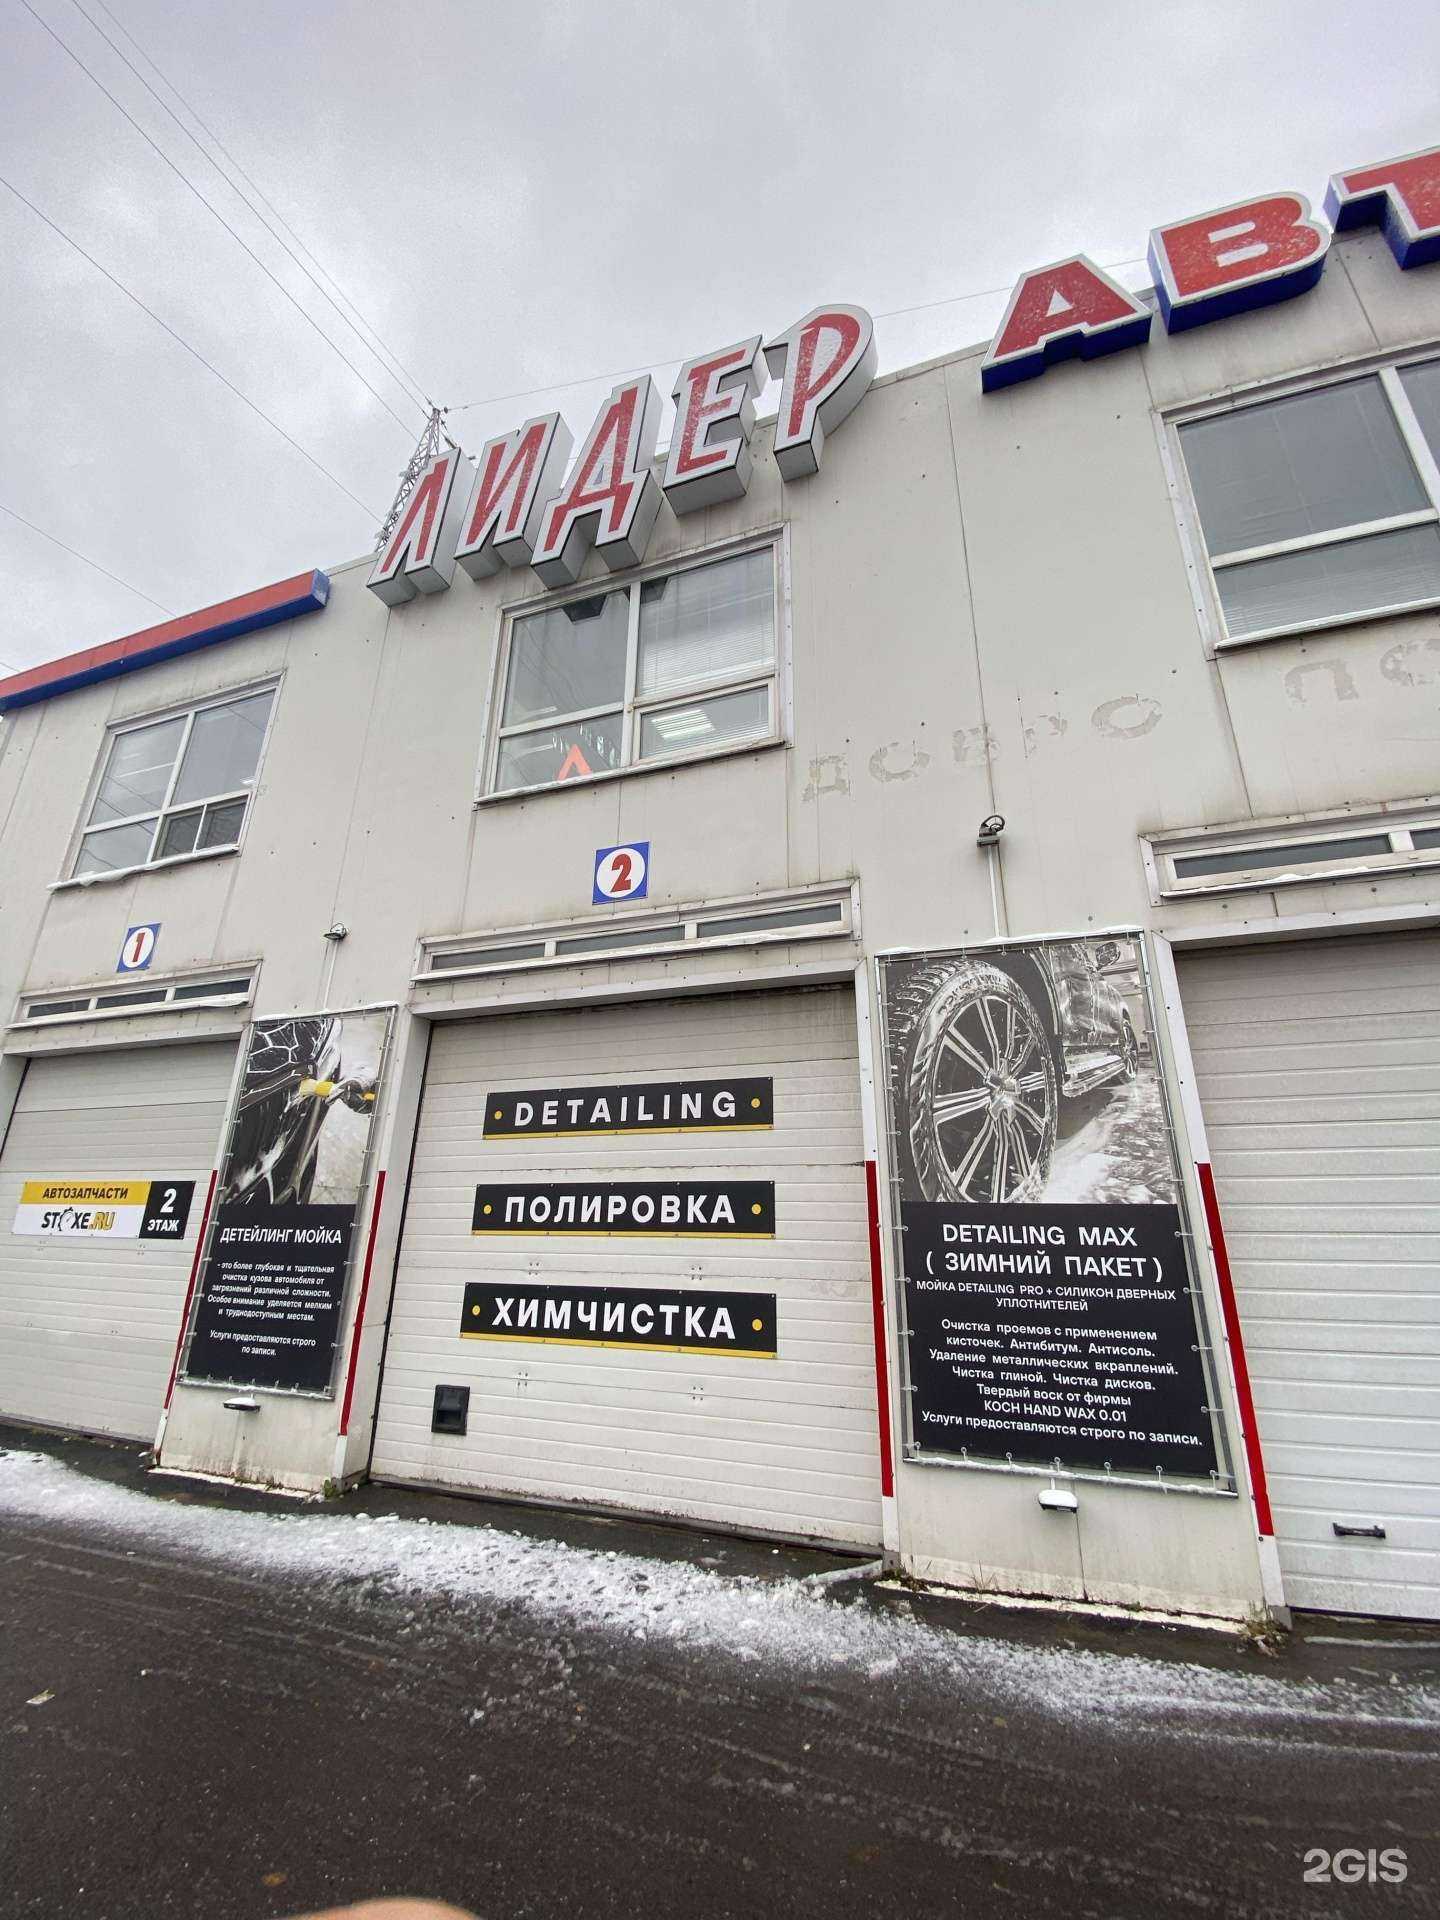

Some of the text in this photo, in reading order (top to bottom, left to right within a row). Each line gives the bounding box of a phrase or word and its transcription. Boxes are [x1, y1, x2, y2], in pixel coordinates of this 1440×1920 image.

[366, 302, 878, 606] ЛИДЕР
[610, 853, 633, 893] 2
[132, 932, 146, 963] 1
[513, 1090, 737, 1128] DETAILING
[43, 1188, 128, 1199] АВТОЗАПЧАСТИ
[160, 1188, 177, 1213] 2
[504, 1194, 737, 1224] ПОЛИРОВКА
[147, 1220, 179, 1232] ЭТАЖ
[220, 1225, 342, 1243] ДЕТЕЙЛИНГ МОЙКА
[942, 1224, 1137, 1246] DETAILING MAX
[255, 1262, 284, 1272] глубокая
[295, 1265, 334, 1273] тщательная
[945, 1251, 1051, 1274] ЗИМНИЙ
[1065, 1255, 1146, 1277] ПАКЕТ
[254, 1286, 289, 1295] различной
[274, 1275, 316, 1285] автомобиля
[917, 1280, 956, 1292] МОЙКА
[958, 1282, 1014, 1294] DETAILING
[1020, 1286, 1043, 1295] PRO
[1055, 1287, 1113, 1298] СИЛИКОН
[1117, 1289, 1176, 1300] ДВЕРНЫХ
[267, 1300, 301, 1308] уделяется
[304, 1302, 332, 1310] мелким
[996, 1297, 1088, 1311] УПЛОТНИТЕЛЕЙ
[492, 1296, 737, 1340] ХИМЧИСТКА
[210, 1330, 316, 1346] Услуги предоставляются строго
[941, 1319, 1157, 1341] Очистка проемов с применением
[251, 1348, 276, 1356] записи.
[946, 1336, 1155, 1357] кисточек. Антибитум. Антисоль.
[929, 1349, 1178, 1375] Удаление металлических вкраплений.
[952, 1366, 1156, 1390] Чистка глиной. Чистка дисков.
[977, 1383, 1131, 1406] Твердый воск от фирмы
[984, 1400, 1020, 1413] KOCH
[1023, 1404, 1061, 1417] HAND
[1064, 1407, 1096, 1420] WAX
[922, 1411, 1202, 1446] Услуги предоставляются строго по записи.
